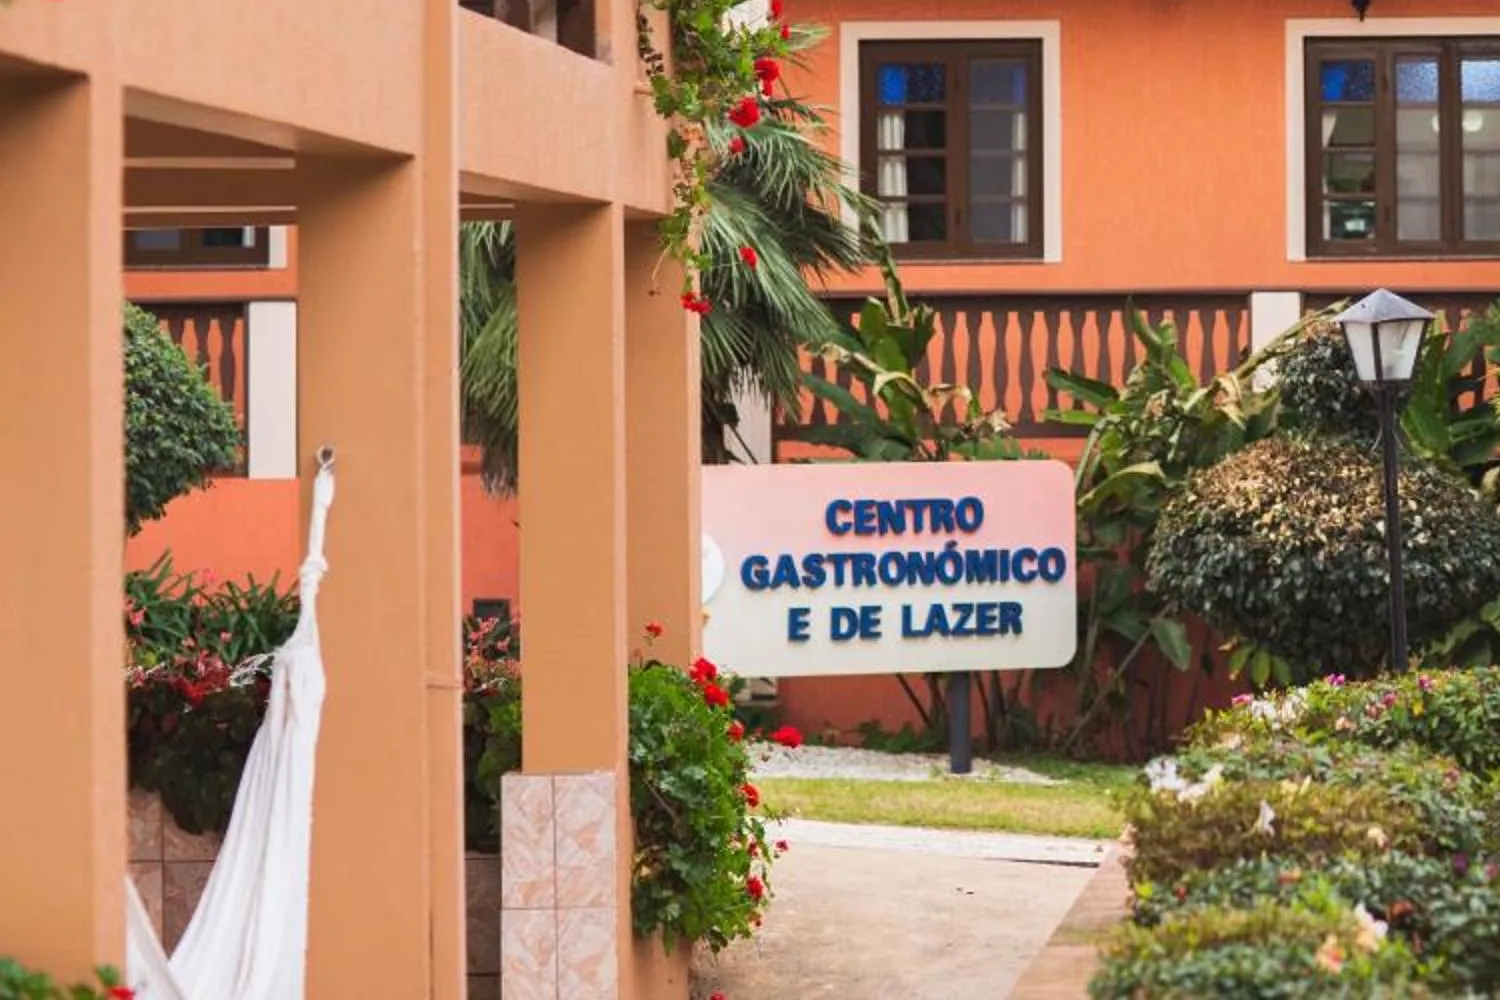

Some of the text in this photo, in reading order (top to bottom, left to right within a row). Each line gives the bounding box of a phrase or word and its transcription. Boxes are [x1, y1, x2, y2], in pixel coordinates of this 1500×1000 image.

[825, 496, 985, 536] CENTRO
[740, 540, 1067, 591] GASTRONÓMICO
[788, 600, 1024, 641] E DE LAZER
